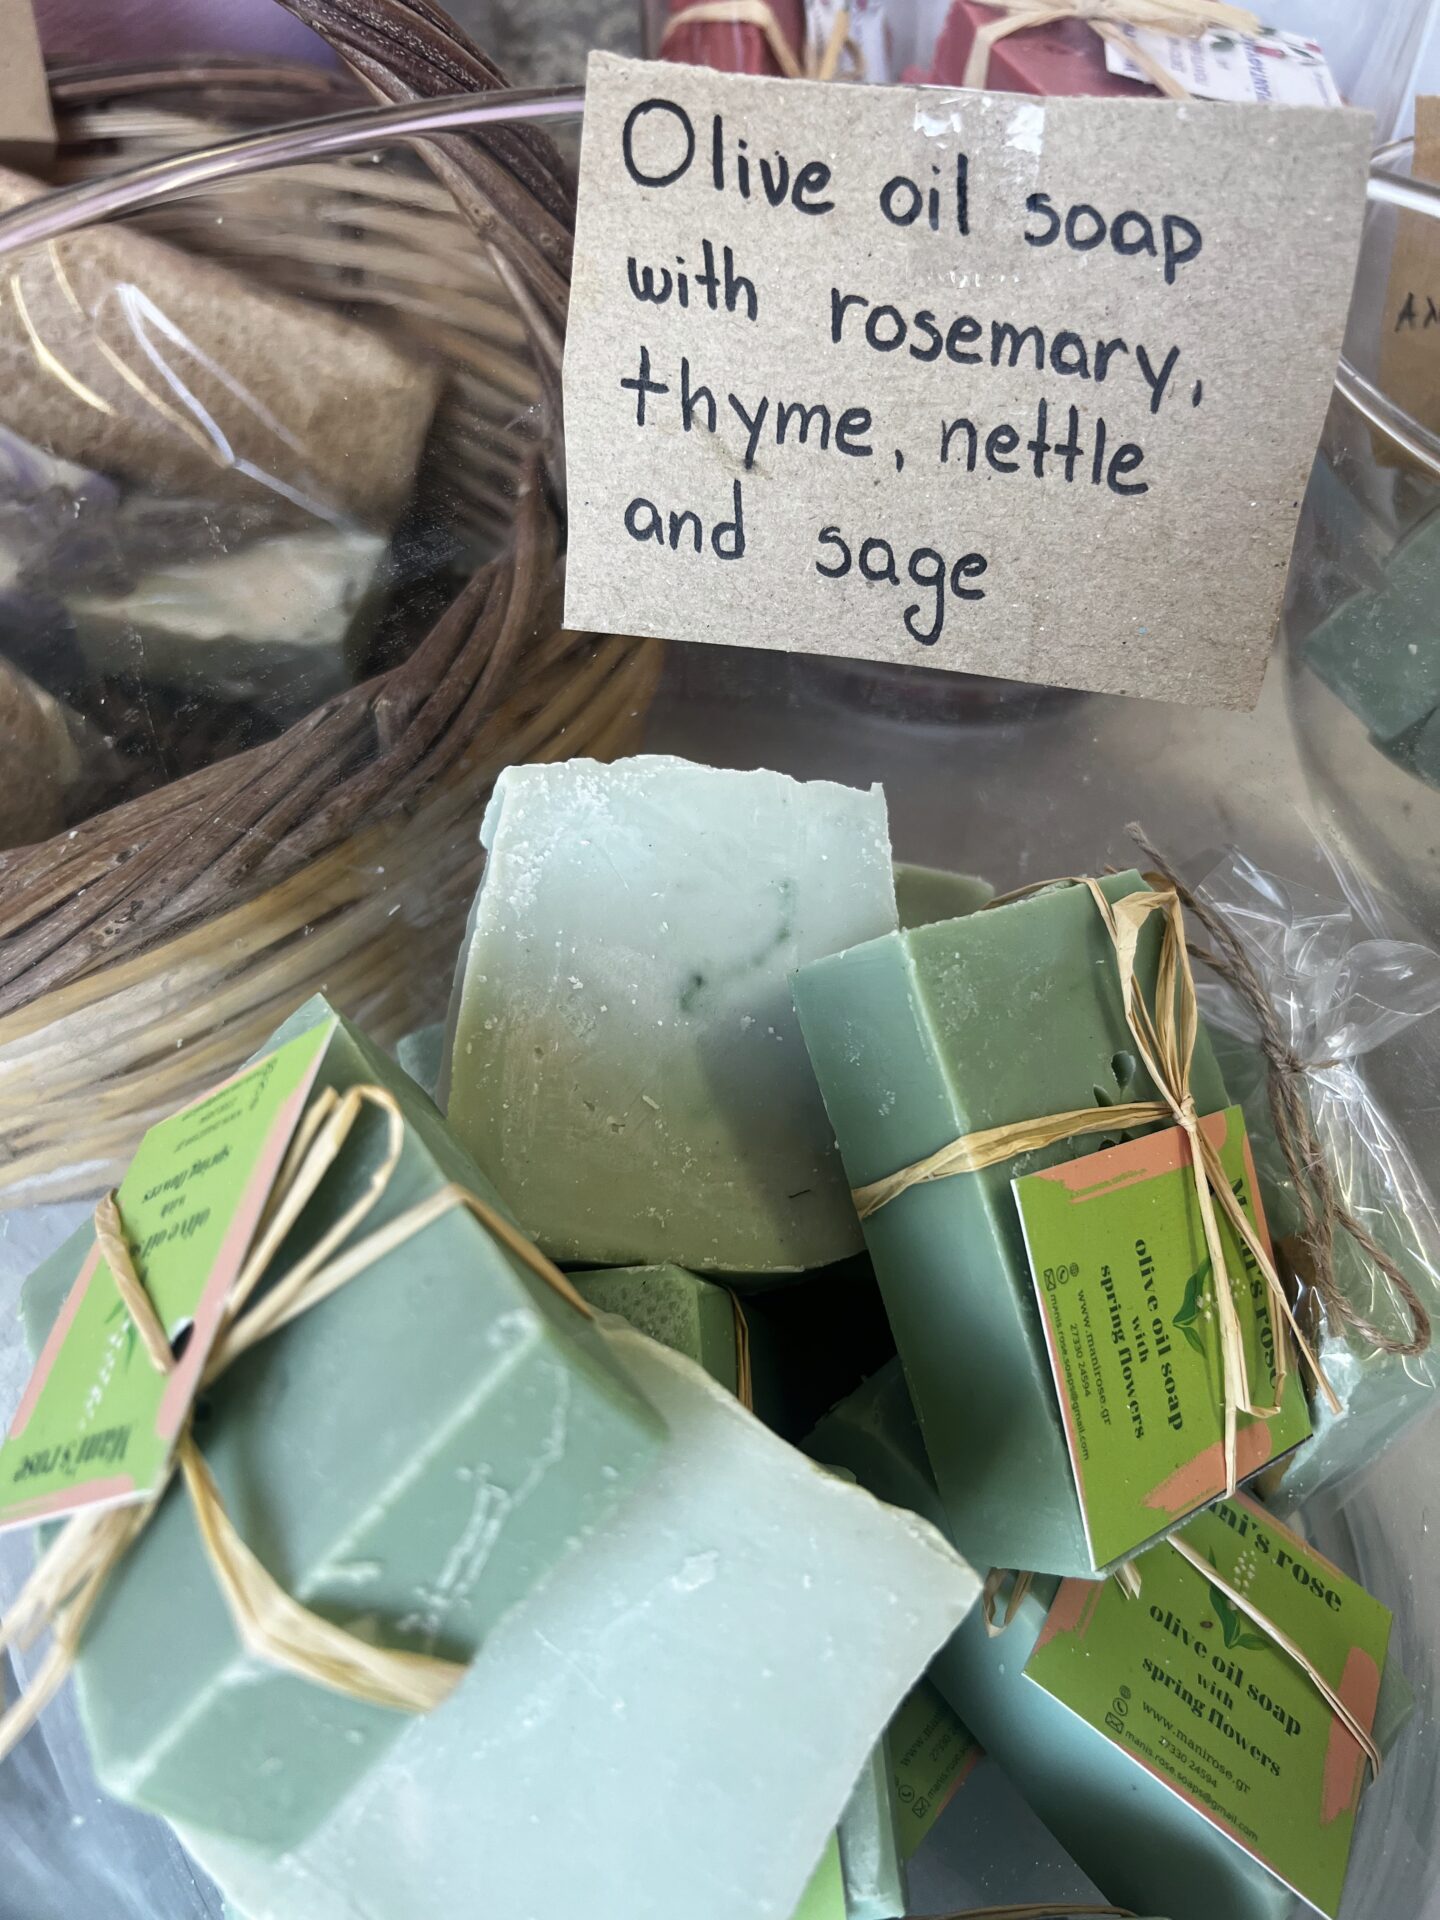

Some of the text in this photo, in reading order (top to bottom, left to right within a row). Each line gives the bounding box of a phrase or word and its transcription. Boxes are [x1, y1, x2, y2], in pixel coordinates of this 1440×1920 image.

[623, 98, 1202, 285] Olive oil soap
[627, 239, 1202, 414] with rosemary,
[620, 345, 1149, 496] thyme, nettle
[624, 478, 988, 646] and sage
[1070, 1323, 1083, 1359] 27330
[1077, 1289, 1112, 1426] www.manirose.gr
[1101, 1264, 1144, 1439] spring flowers
[1131, 1315, 1148, 1364] with
[1135, 1239, 1183, 1431] olive oil soap
[1275, 1549, 1342, 1612] rose
[1142, 1658, 1281, 1777] spring flowers
[1150, 1605, 1301, 1736] olive oil soap
[1197, 1673, 1233, 1711] with
[1142, 1701, 1251, 1793] www.manirose.gr
